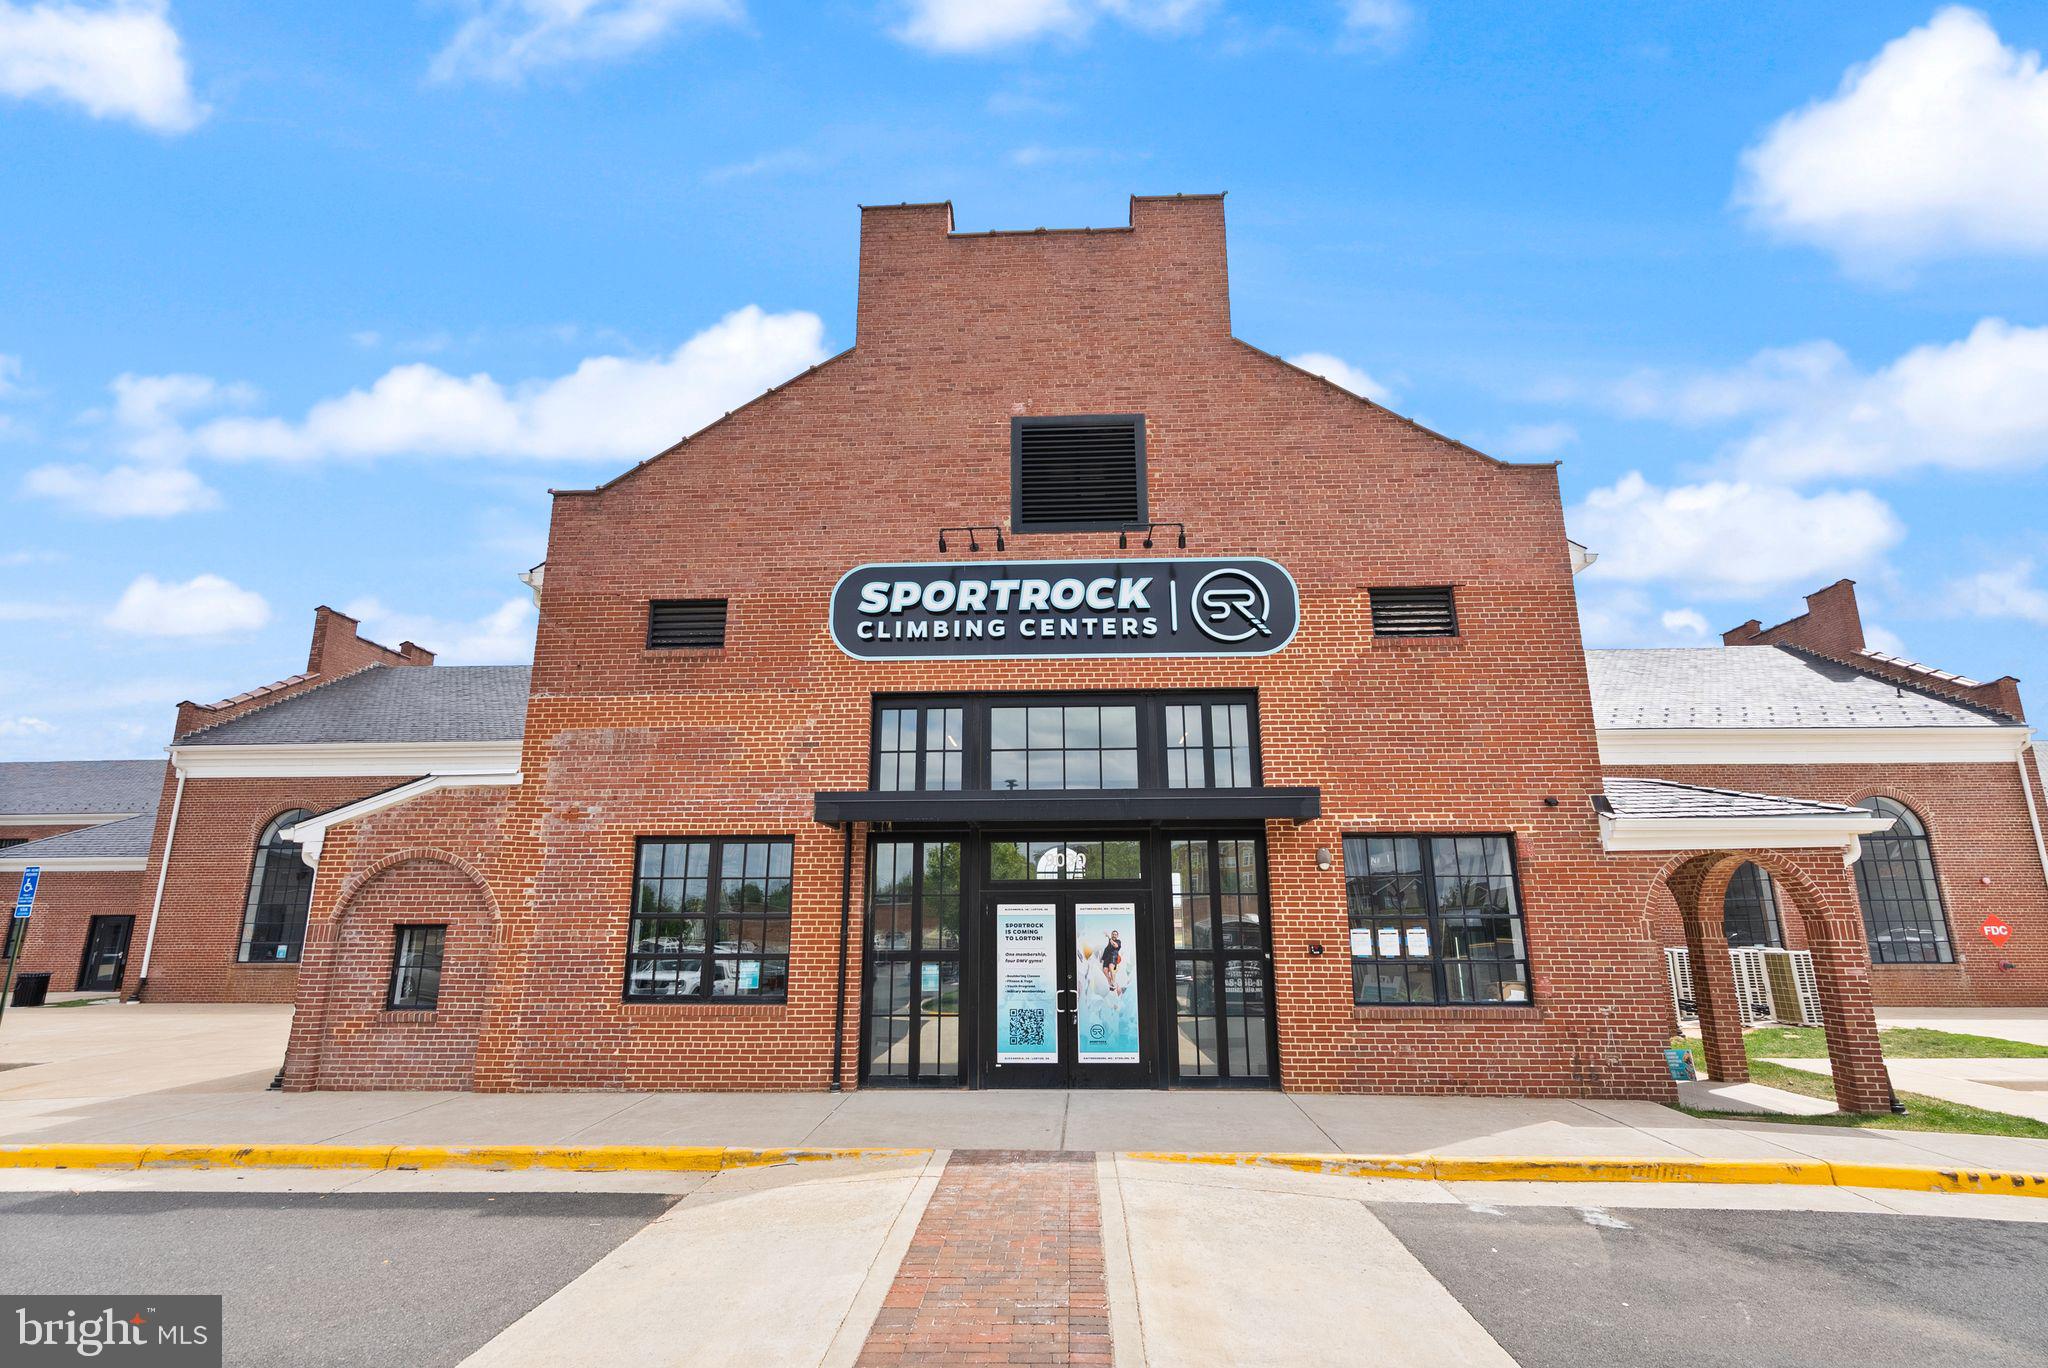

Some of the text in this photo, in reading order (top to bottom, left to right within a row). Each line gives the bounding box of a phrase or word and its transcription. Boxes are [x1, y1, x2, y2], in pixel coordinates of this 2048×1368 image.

[859, 576, 1154, 614] SPORTROCK
[856, 616, 1158, 640] CLIMBING CENTERS
[1983, 925, 2008, 936] FDC
